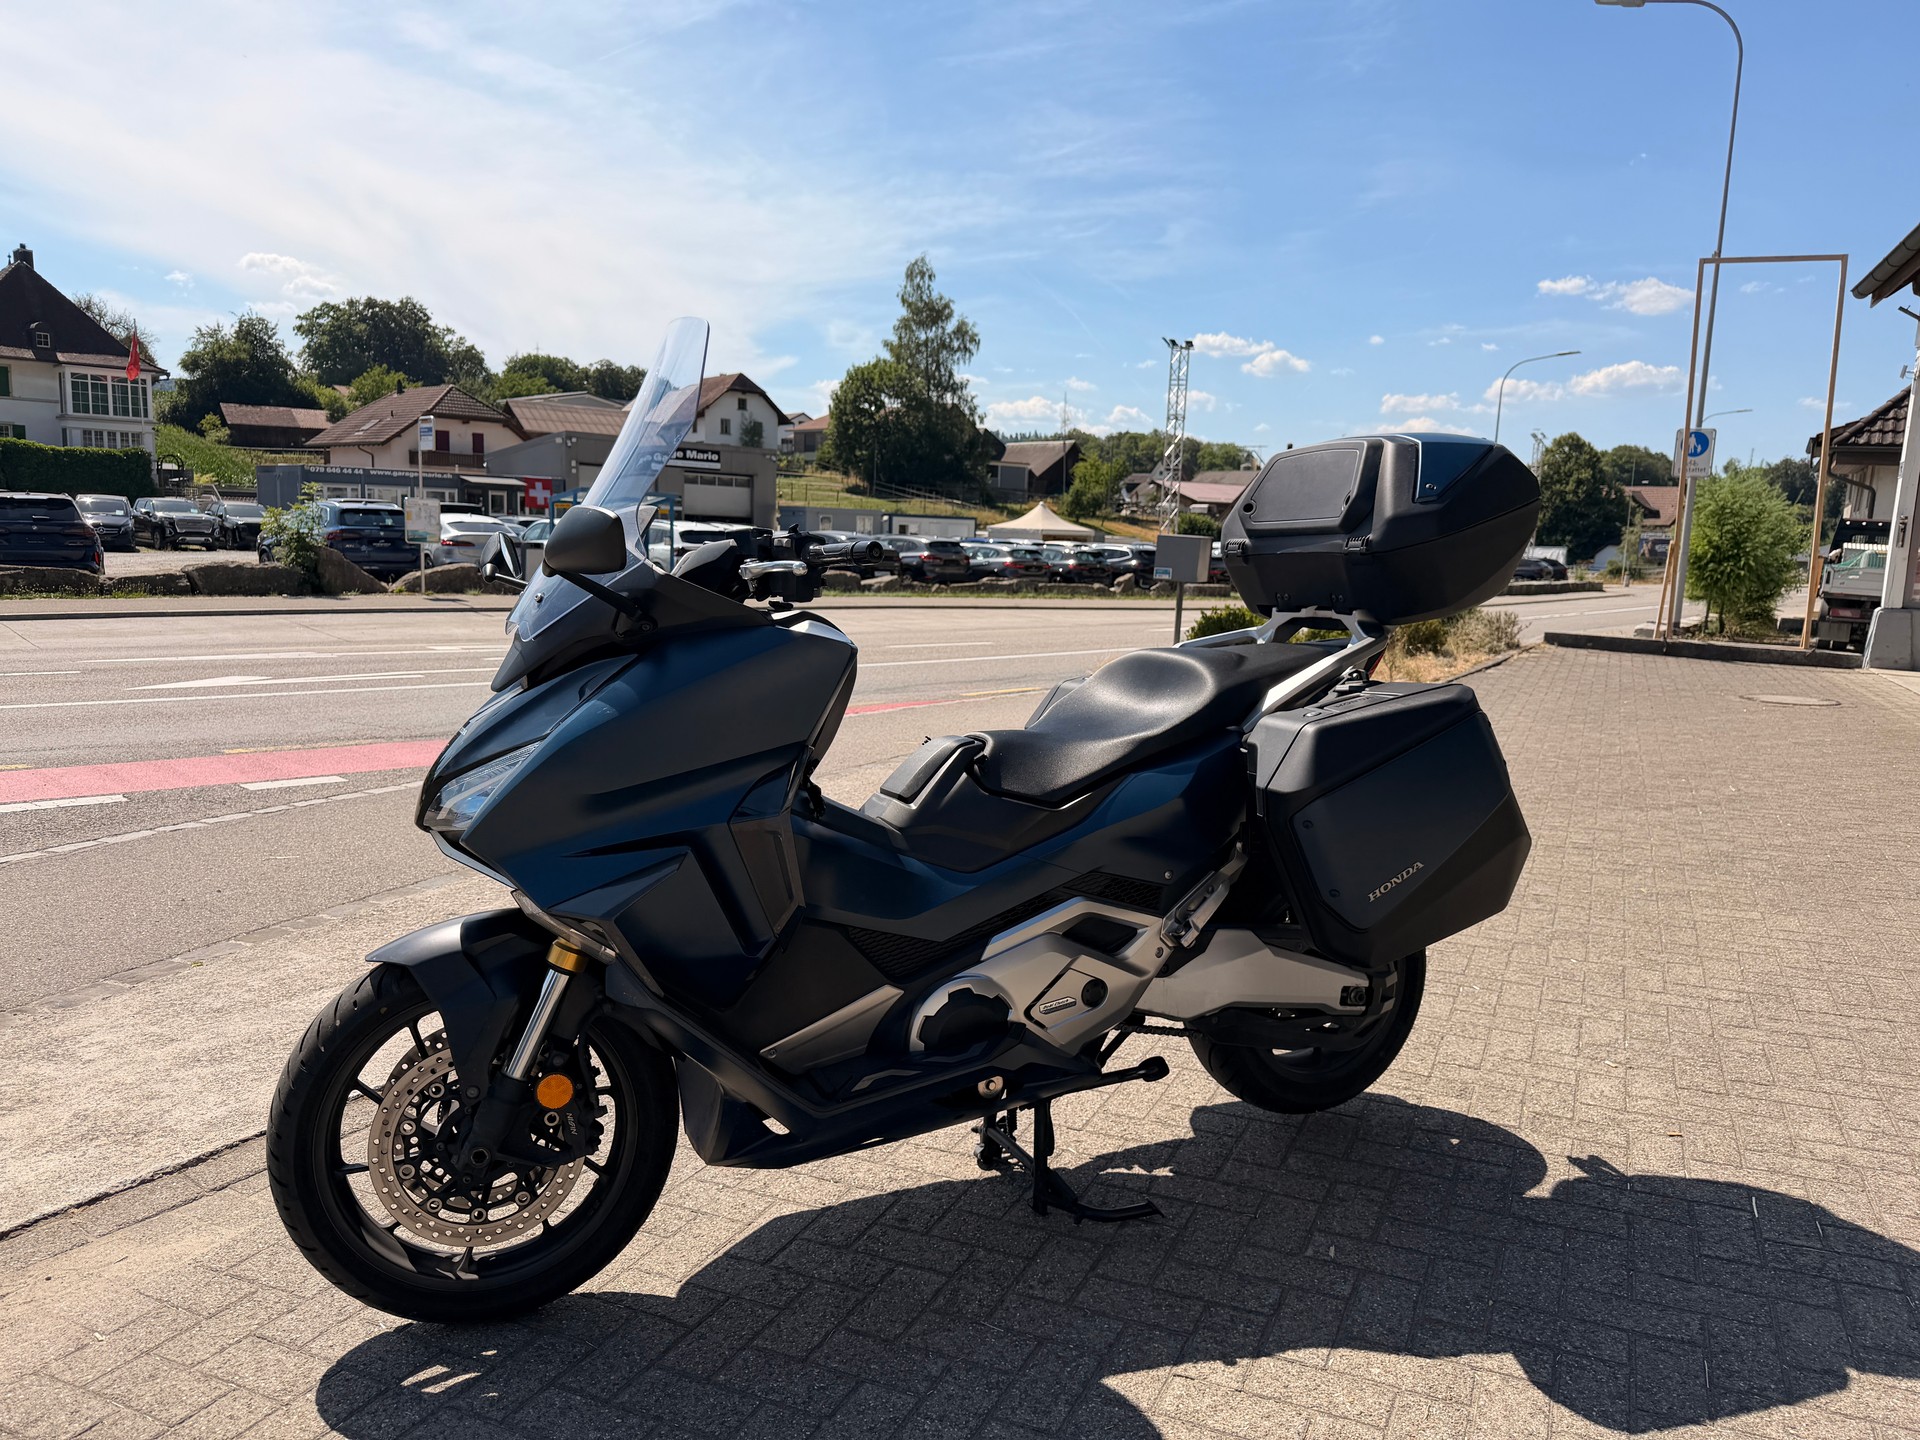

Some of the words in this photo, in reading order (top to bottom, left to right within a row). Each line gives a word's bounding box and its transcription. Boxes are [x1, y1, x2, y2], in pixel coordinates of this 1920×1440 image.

[685, 449, 719, 461] Mario
[369, 469, 453, 479] www.garagemario.ch
[1367, 861, 1424, 902] HONDA
